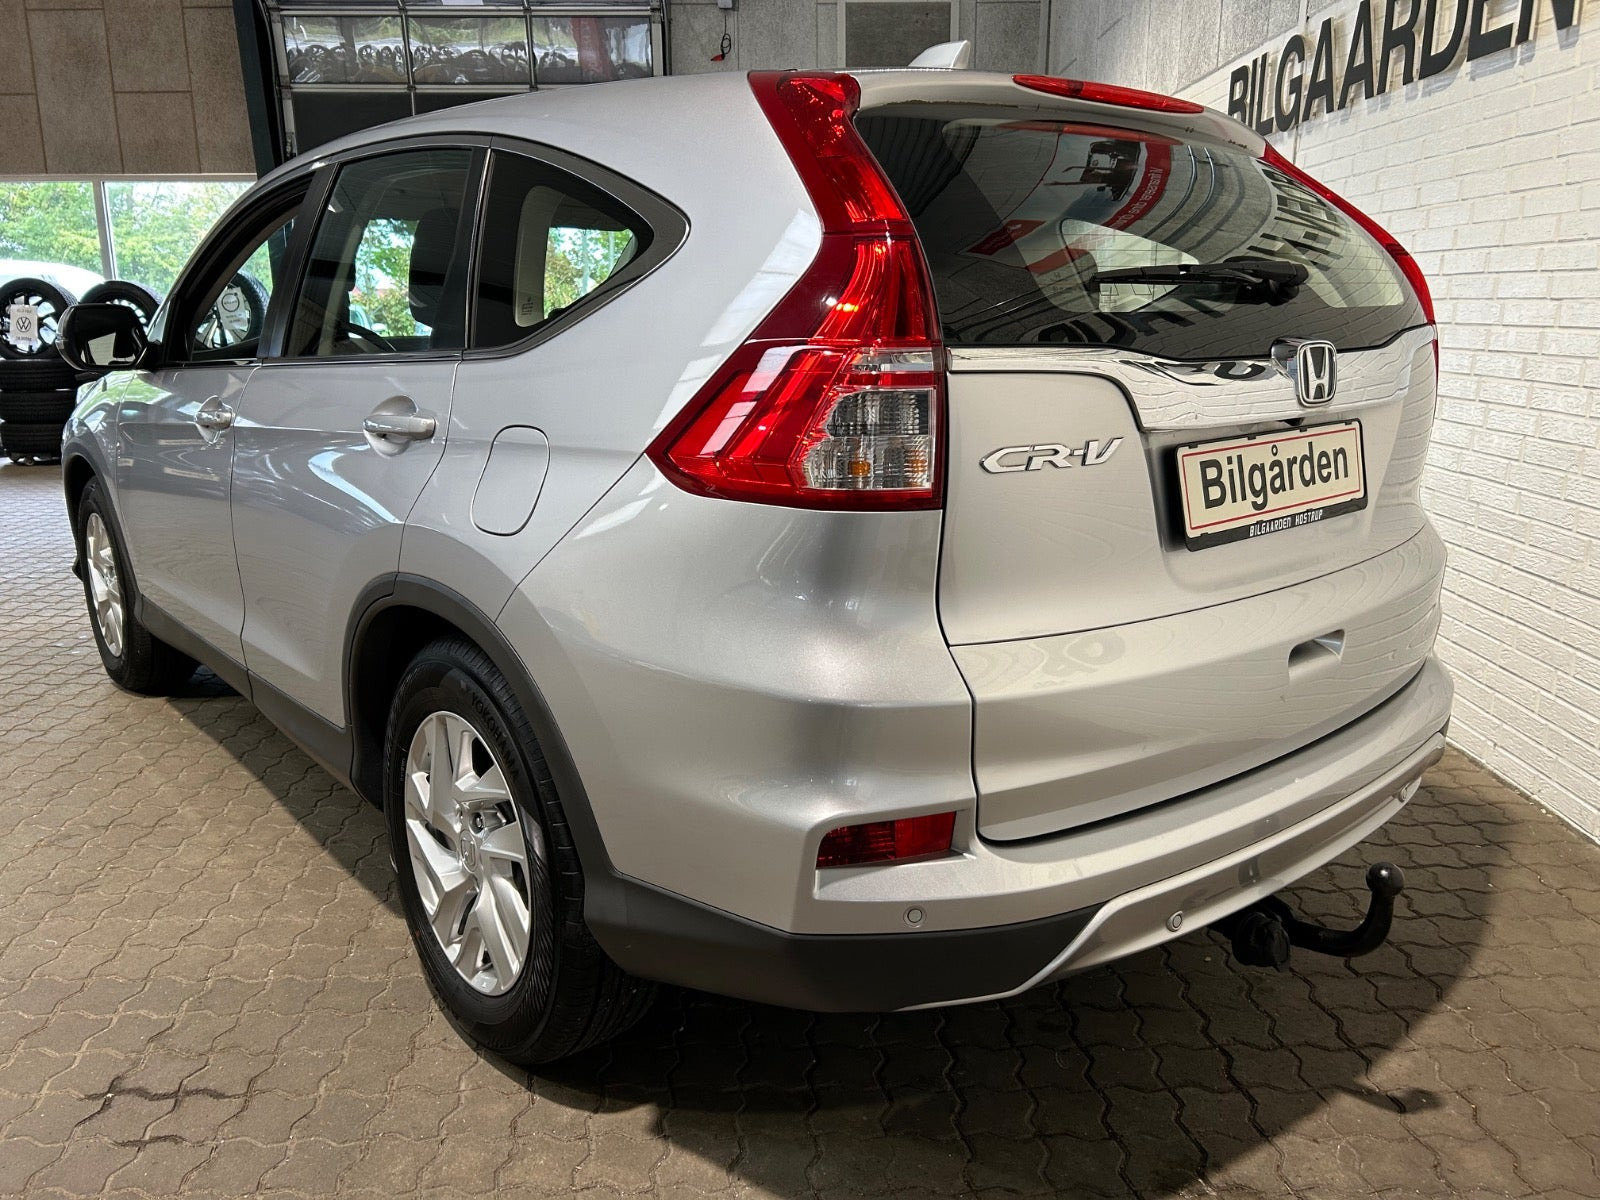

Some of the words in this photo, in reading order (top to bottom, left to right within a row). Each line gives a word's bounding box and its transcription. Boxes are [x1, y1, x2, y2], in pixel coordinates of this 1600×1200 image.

[1228, 0, 1575, 133] BILGAARD
[979, 437, 1124, 474] CR-V
[1200, 441, 1348, 511] Bilgården
[1249, 517, 1292, 537] BILGAARDEN
